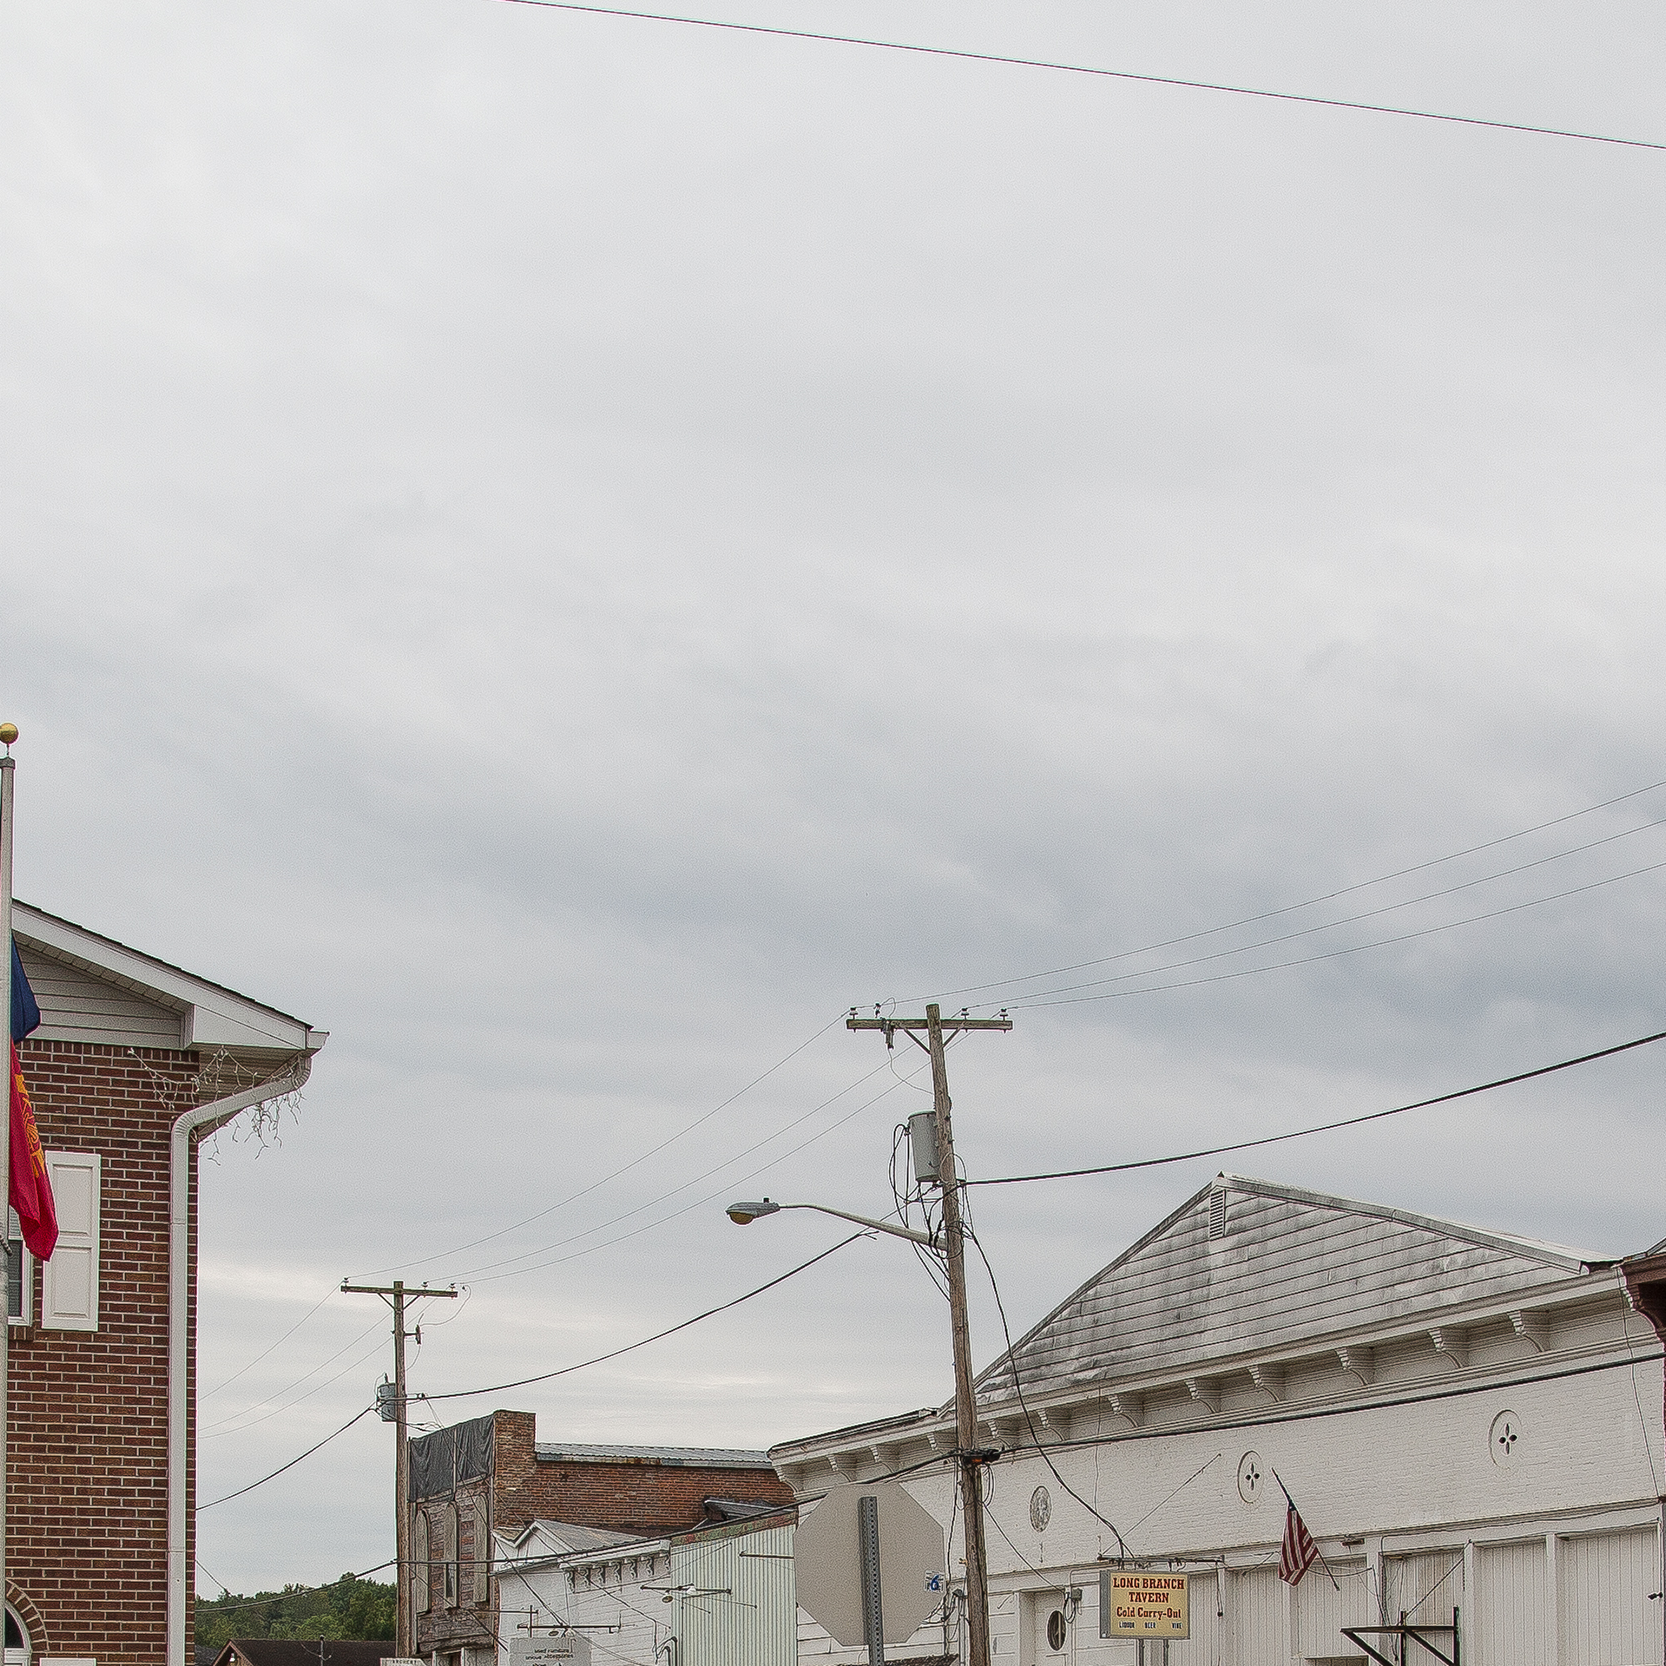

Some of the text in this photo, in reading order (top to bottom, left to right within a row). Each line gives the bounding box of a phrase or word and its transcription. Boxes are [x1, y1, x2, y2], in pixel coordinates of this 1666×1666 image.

[1113, 1577, 1185, 1589] LONG BRANCH
[1129, 1592, 1169, 1603] TAVERN
[1116, 1606, 1181, 1620] Cold Carry-Out
